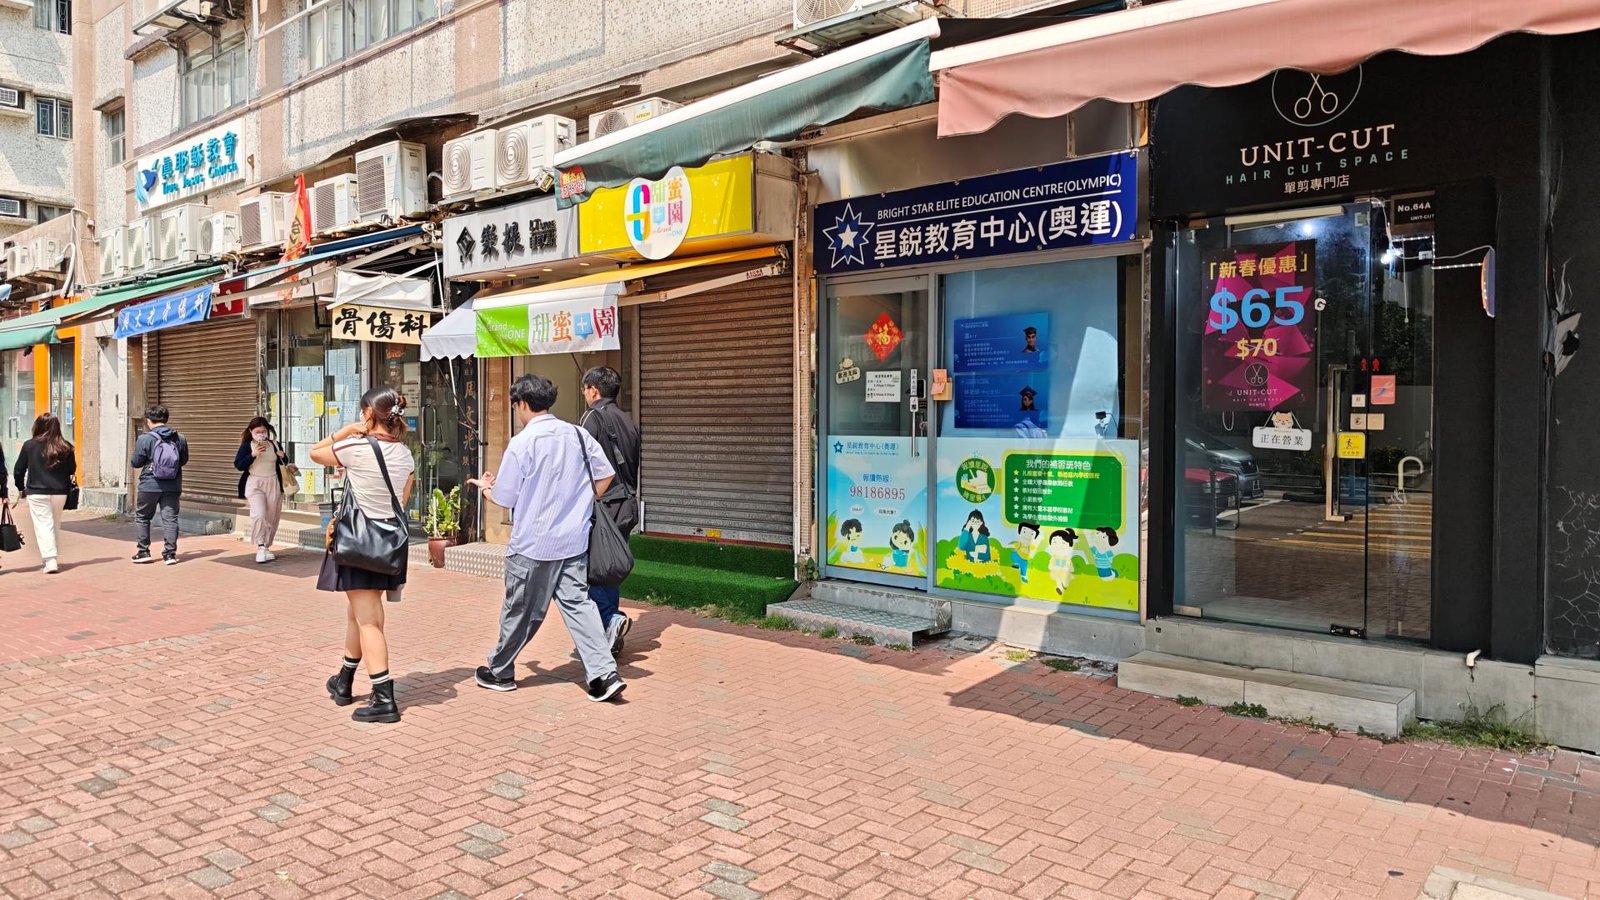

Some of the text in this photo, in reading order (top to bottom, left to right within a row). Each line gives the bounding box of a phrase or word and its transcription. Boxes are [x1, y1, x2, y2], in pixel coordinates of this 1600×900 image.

[1240, 124, 1395, 167] UNIT-CUT
[208, 162, 238, 178] Church
[1226, 148, 1408, 184] HAIR CUT SPACE
[1283, 174, 1350, 194] 單剪專門店
[877, 173, 1121, 221] BRIGHT STAR ELITE EDUCATION CENTRE(OLYMPIC)
[1397, 202, 1431, 213] No.64A
[1210, 253, 1308, 280] 「新春優惠」
[1209, 286, 1305, 334] $65
[335, 308, 428, 341] 骨傷科
[507, 328, 526, 341] ONE
[1236, 338, 1278, 360] $70
[1261, 433, 1304, 447] 正在營業
[1026, 459, 1091, 470] 我們的補習班特色
[850, 486, 905, 501] 98186895
